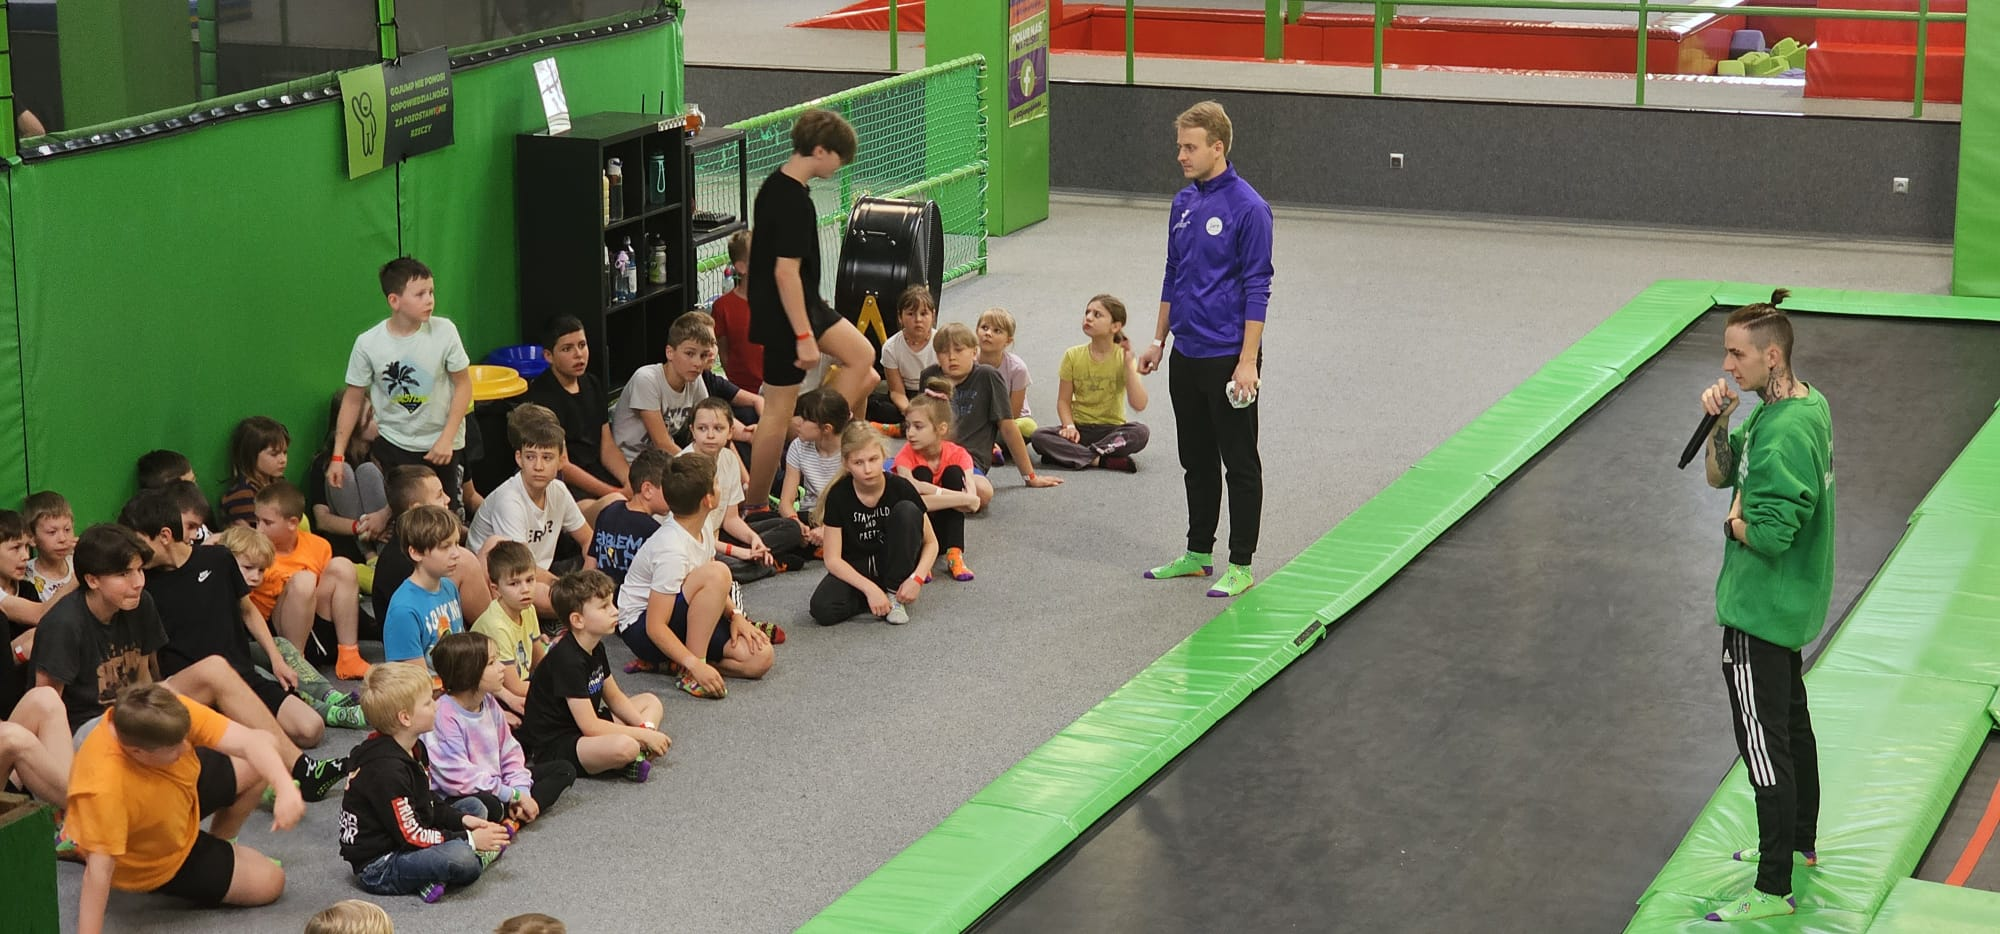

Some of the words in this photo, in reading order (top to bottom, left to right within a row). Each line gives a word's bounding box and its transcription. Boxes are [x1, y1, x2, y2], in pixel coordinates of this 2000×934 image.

[390, 81, 414, 97] GOJUMP
[415, 78, 424, 89] NIE
[425, 72, 446, 86] PONOSI
[394, 116, 403, 128] ZA
[410, 123, 432, 138] RZECZY
